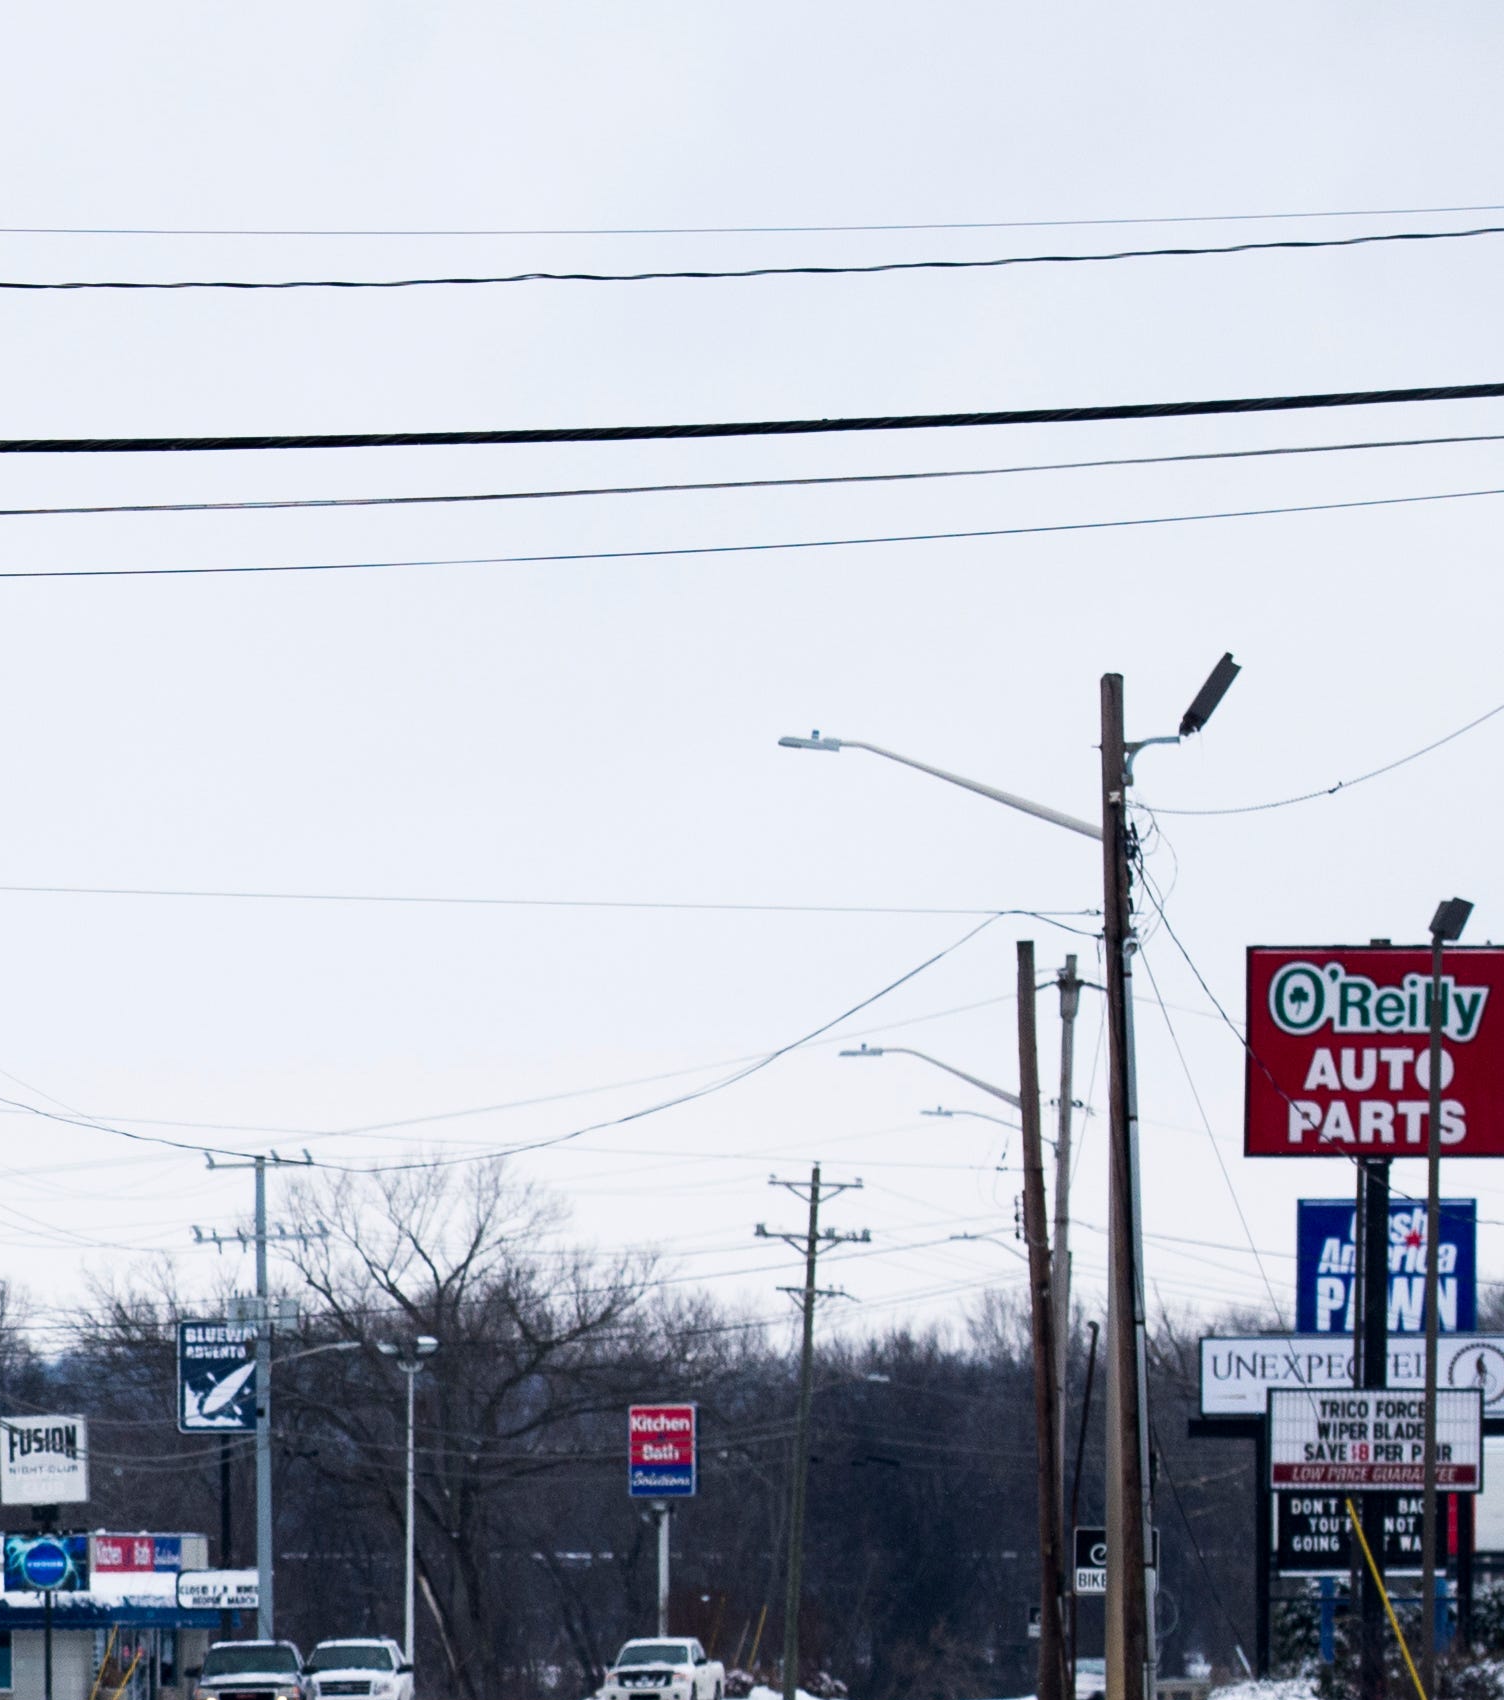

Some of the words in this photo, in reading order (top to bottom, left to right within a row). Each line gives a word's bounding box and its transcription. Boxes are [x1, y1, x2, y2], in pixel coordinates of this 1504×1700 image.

[1272, 964, 1484, 1039] O'Reilly
[1303, 1047, 1454, 1091] AUTO
[1288, 1099, 1466, 1145] PARTS
[1320, 1401, 1369, 1418] TRICO
[1376, 1401, 1426, 1418] FORCE
[631, 1414, 690, 1432] Kitchen
[1317, 1422, 1368, 1439] WIPER
[1373, 1422, 1426, 1438] BLADE
[8, 1425, 77, 1463] FUSION
[1304, 1444, 1347, 1462] SAVE
[1373, 1444, 1403, 1462] PER
[1411, 1444, 1452, 1462] PIR
[1291, 1466, 1324, 1482] LOW
[1327, 1466, 1368, 1482] PRICE
[1291, 1499, 1338, 1514] DON'T
[1398, 1499, 1426, 1514] BAC
[1384, 1517, 1415, 1533] NOT
[1292, 1536, 1339, 1551] GOING
[1400, 1536, 1422, 1551] WA
